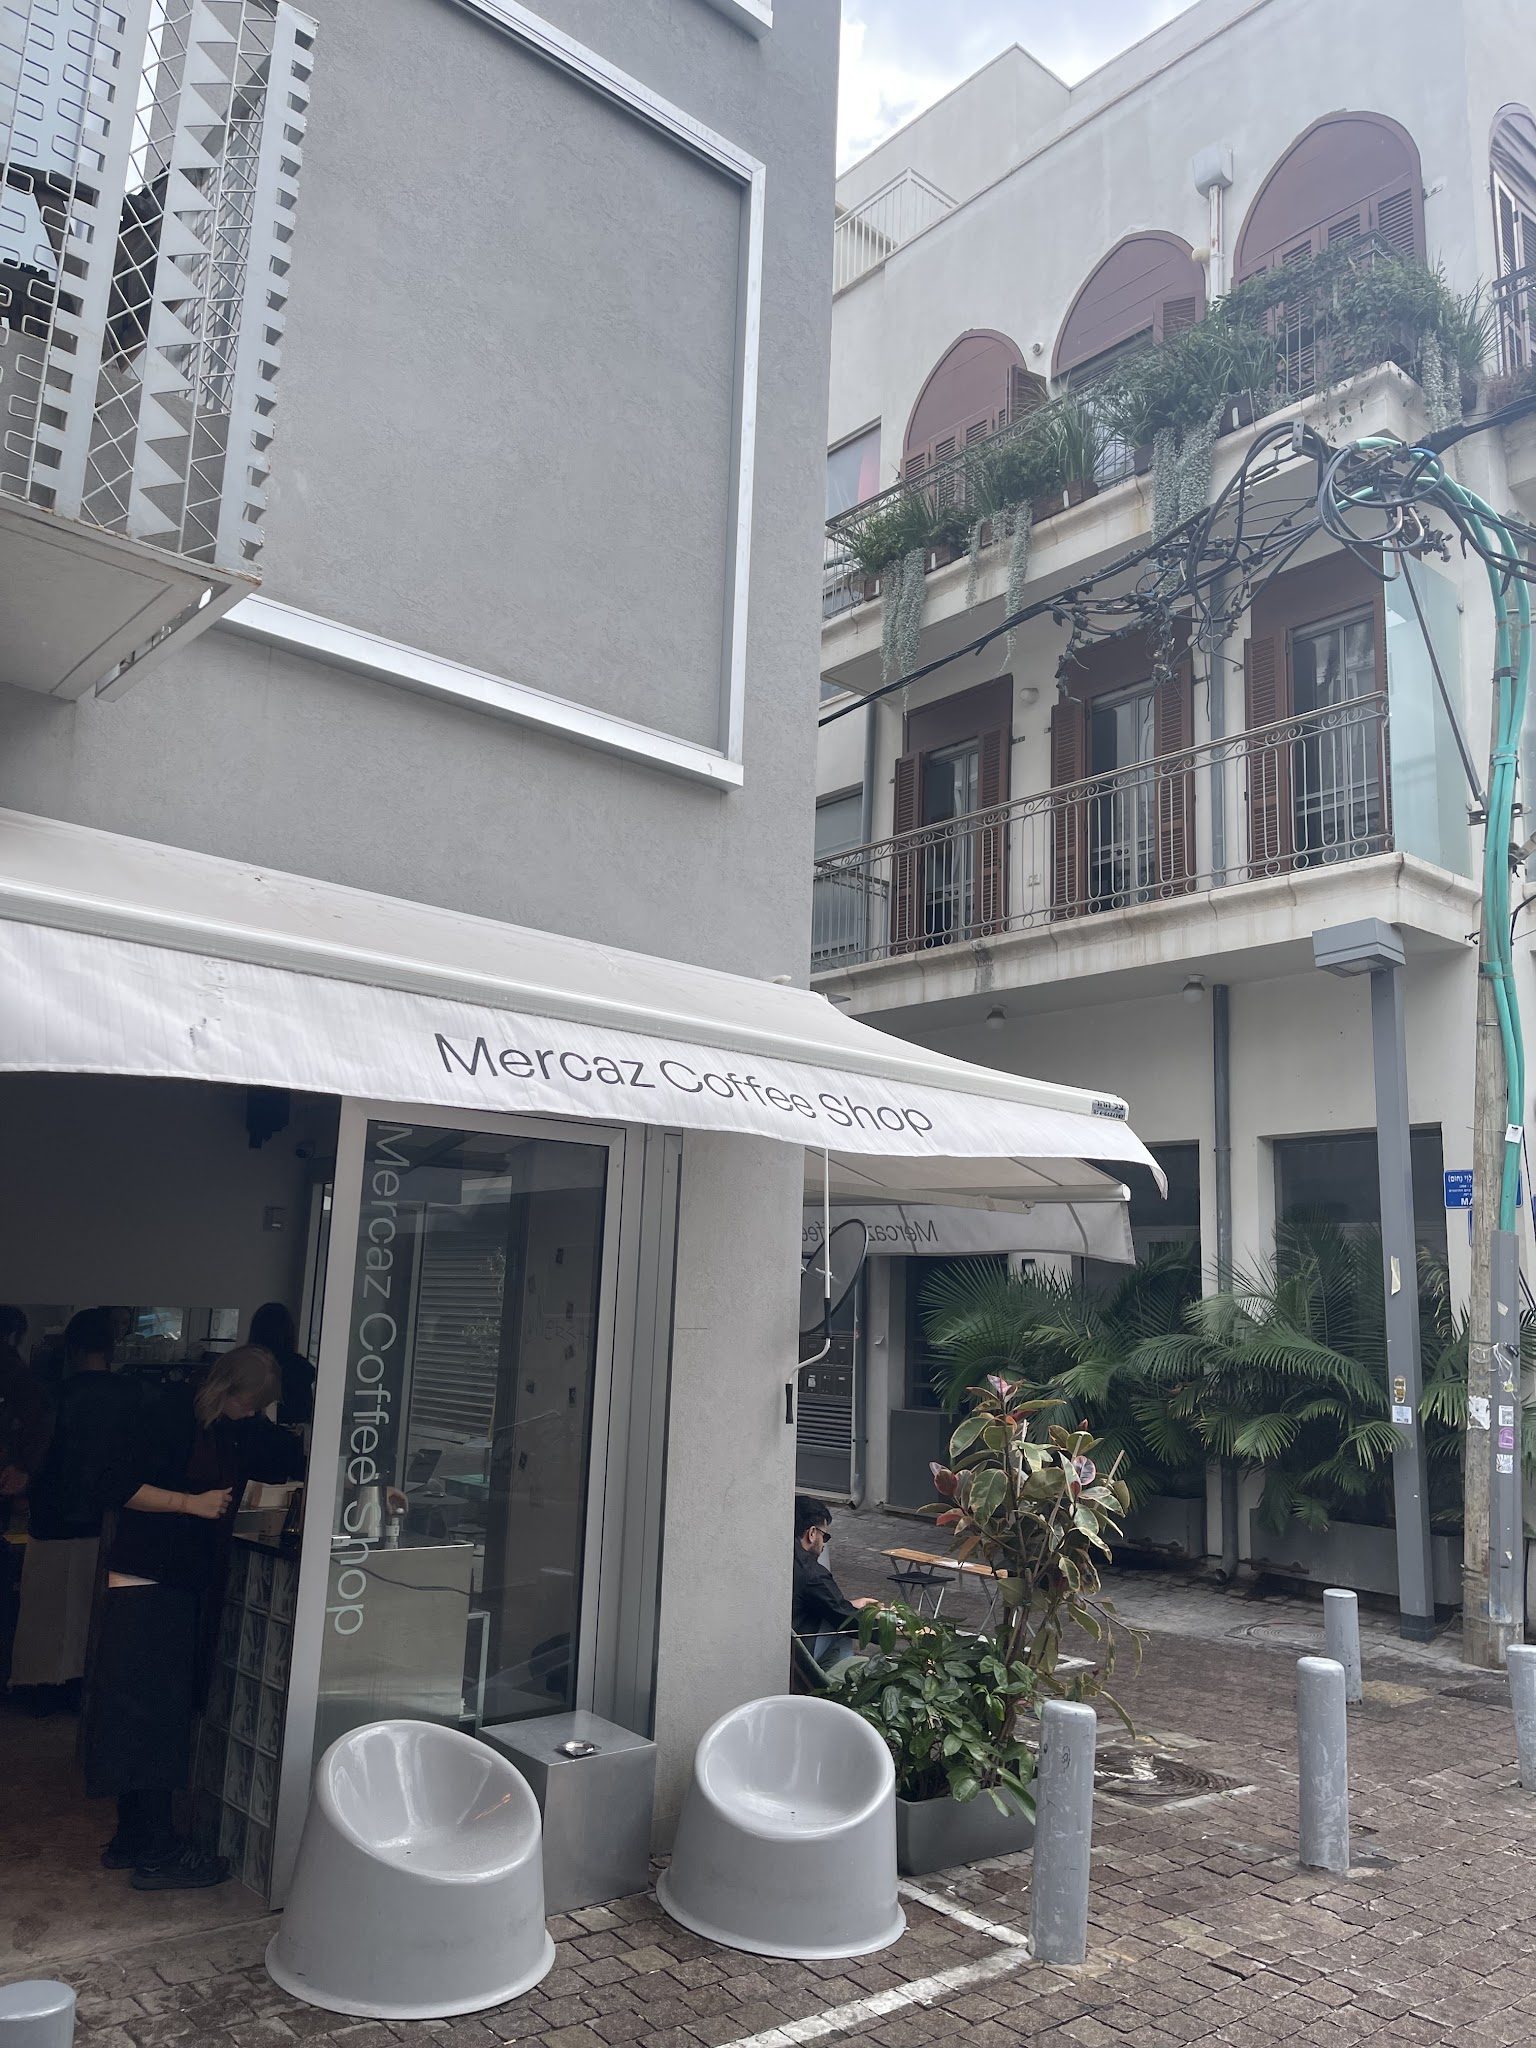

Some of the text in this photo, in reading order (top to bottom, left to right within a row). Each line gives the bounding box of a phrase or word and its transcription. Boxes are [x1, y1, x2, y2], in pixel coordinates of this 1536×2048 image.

[434, 1033, 933, 1137] Mercaz Coffee Shop
[326, 1124, 413, 1636] Mercaz Coffee Shop
